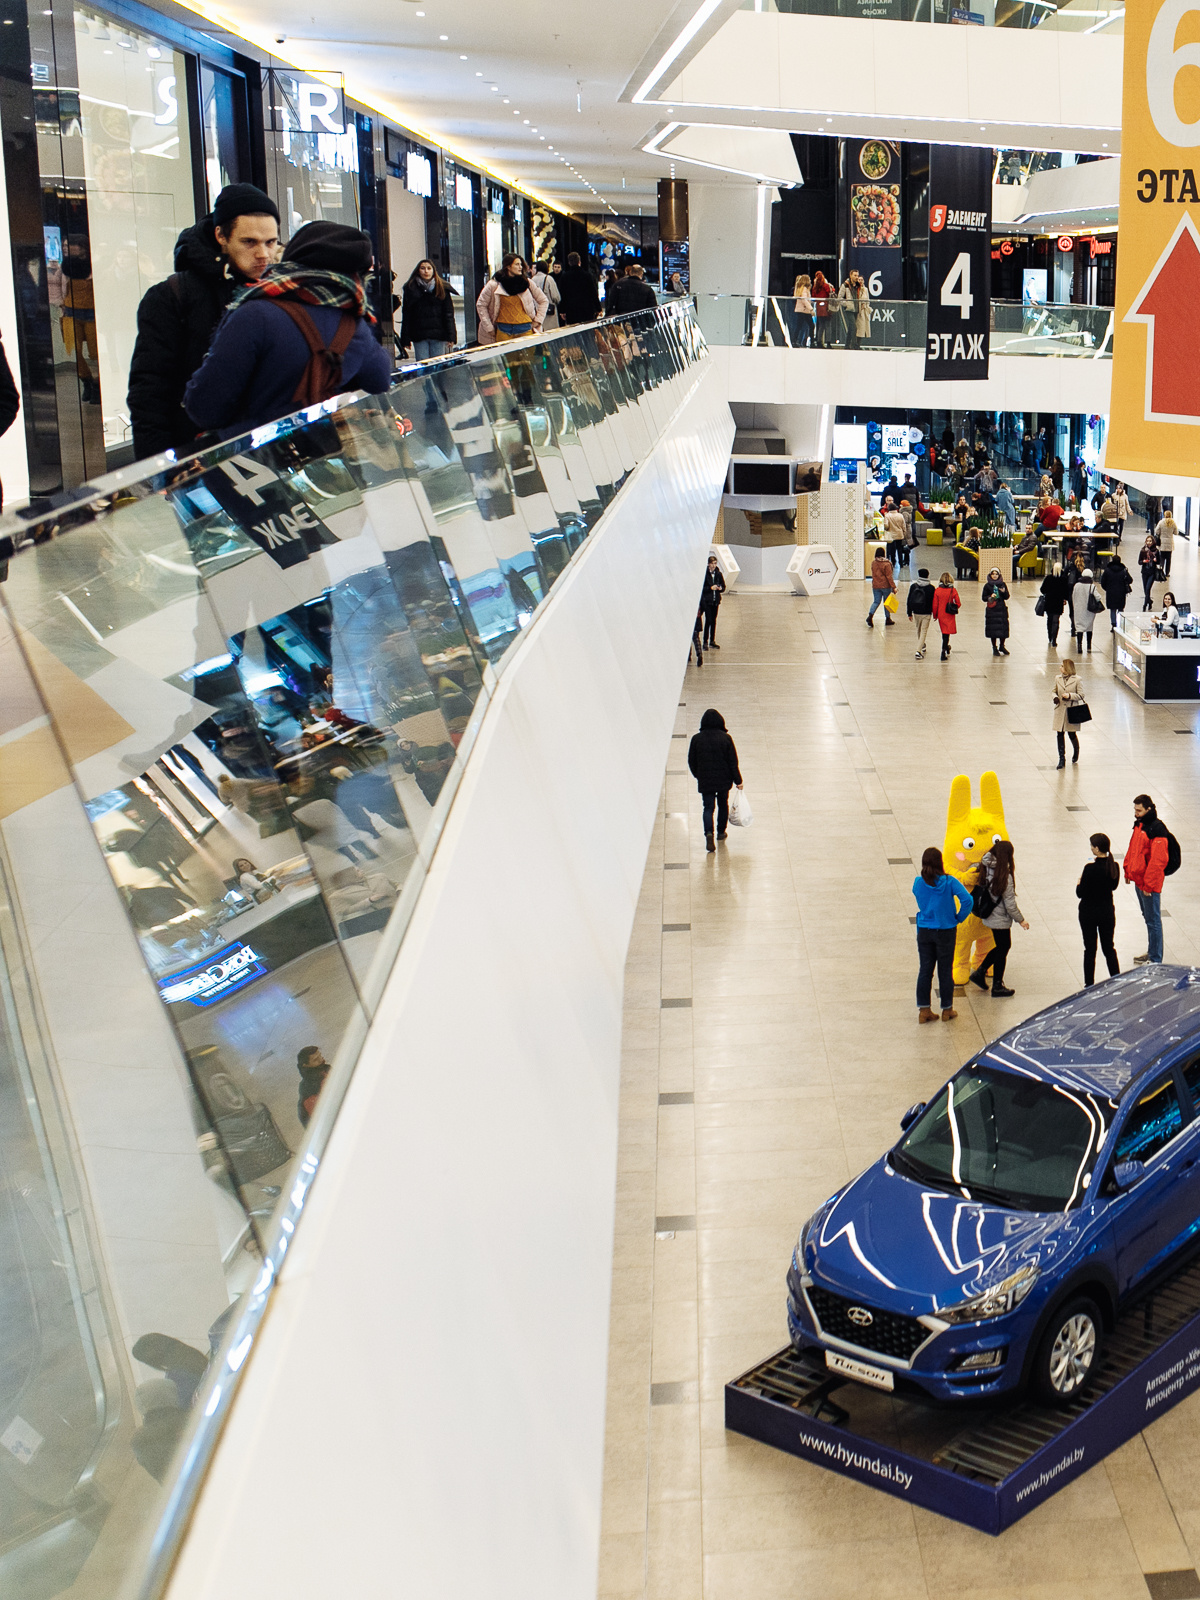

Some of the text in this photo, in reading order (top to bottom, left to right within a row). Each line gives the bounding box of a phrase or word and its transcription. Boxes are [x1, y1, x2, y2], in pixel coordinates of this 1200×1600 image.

[299, 82, 345, 134] R
[932, 208, 988, 228] 5 ЭЛЕМЕНТ
[680, 244, 687, 254] 2
[868, 270, 883, 297] 6
[940, 252, 974, 320] 4
[928, 333, 985, 360] ЭТАЖ
[887, 437, 903, 447] SALE
[832, 1356, 886, 1382] TUCSON
[1145, 1360, 1184, 1394] Автоцентр
[1145, 1377, 1184, 1411] Автоцентр
[799, 1431, 913, 1490] www.hyundai.by
[1016, 1446, 1085, 1503] www.hyundai.by
